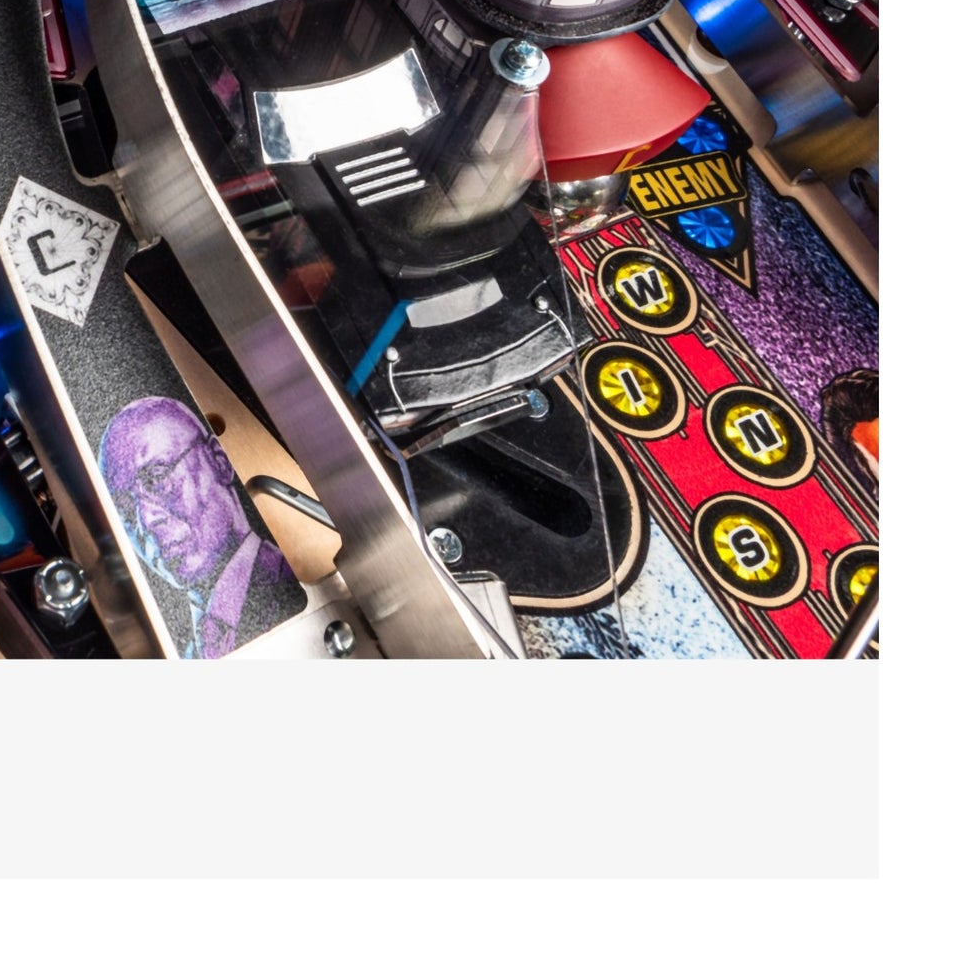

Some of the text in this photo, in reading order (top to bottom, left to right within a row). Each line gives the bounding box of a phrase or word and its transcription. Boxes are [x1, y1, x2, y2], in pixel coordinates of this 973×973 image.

[629, 157, 739, 211] ENEMY
[620, 268, 665, 309] W
[736, 411, 779, 455] N
[730, 527, 766, 568] S
